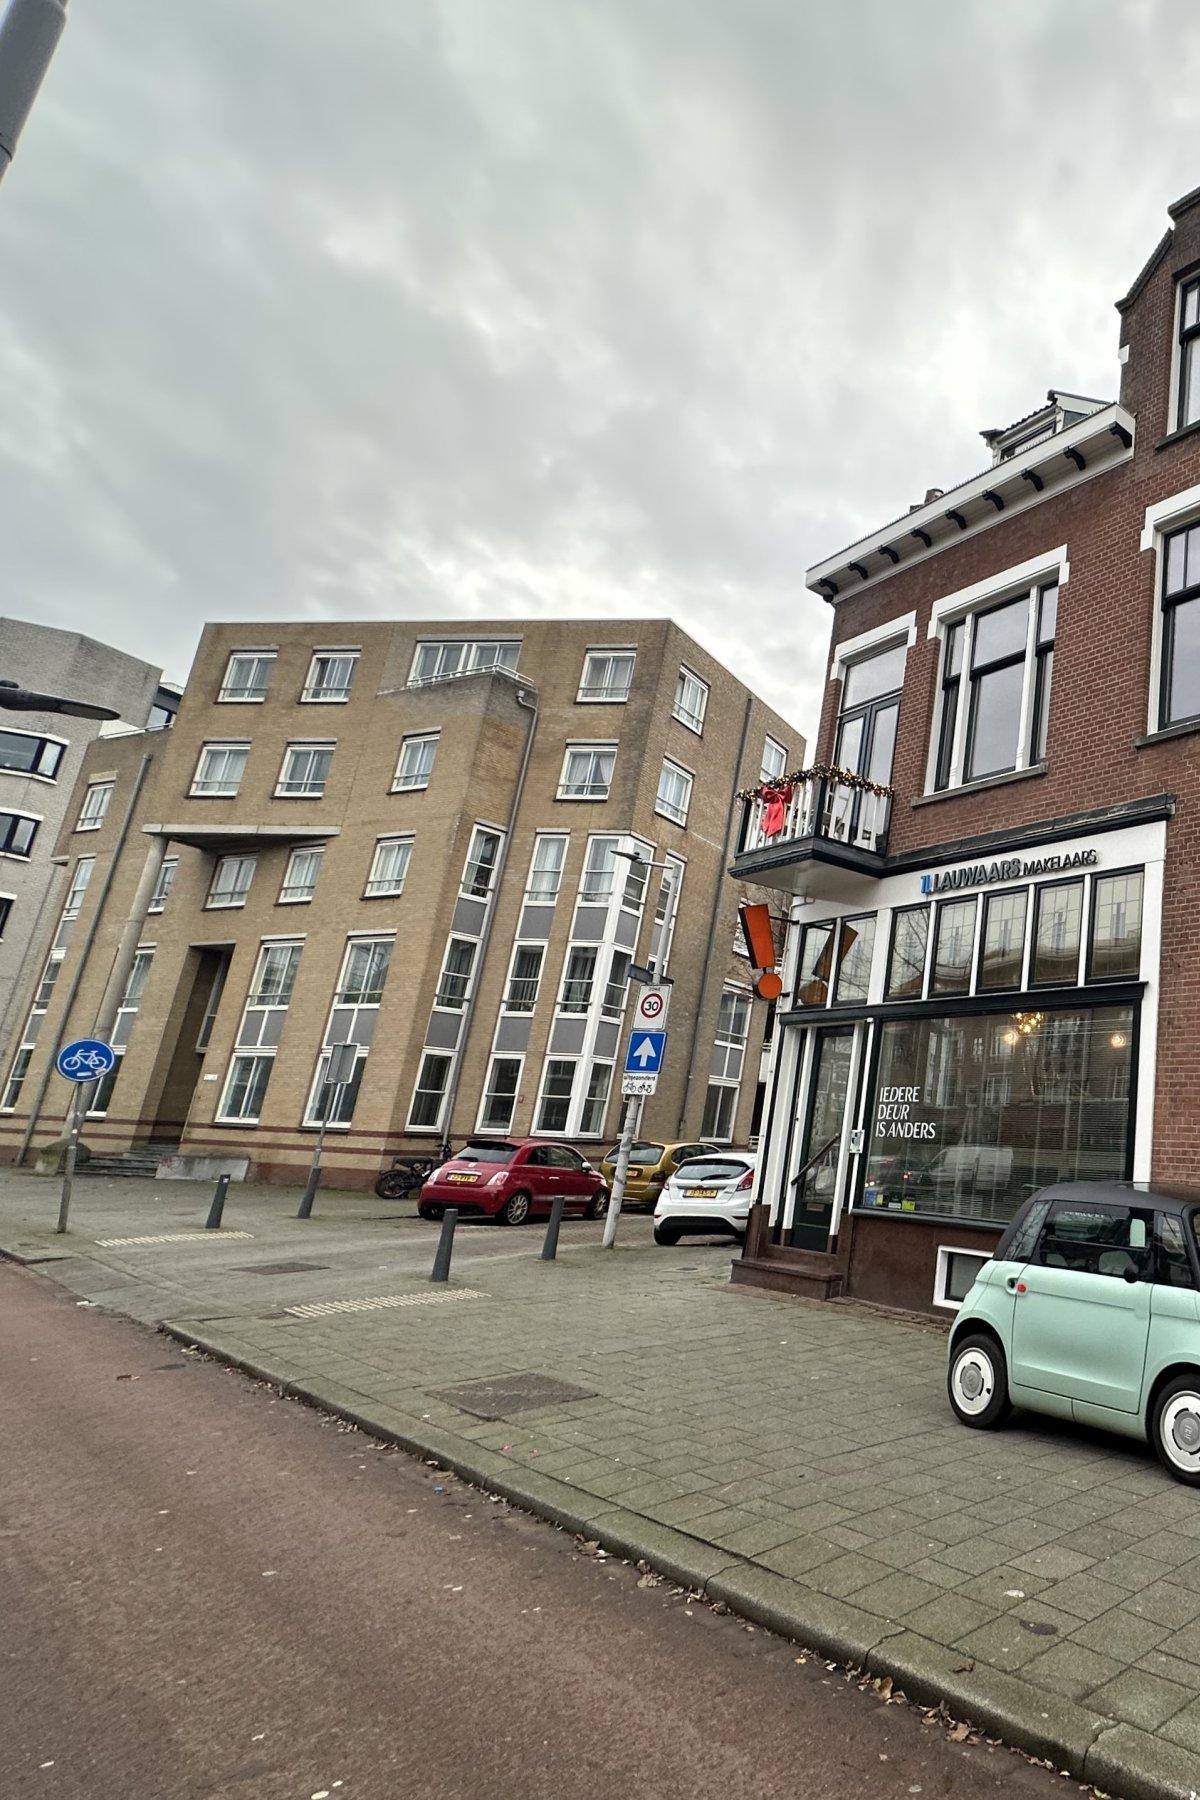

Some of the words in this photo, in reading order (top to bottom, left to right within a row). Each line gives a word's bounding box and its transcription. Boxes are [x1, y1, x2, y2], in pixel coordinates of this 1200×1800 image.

[933, 858, 1021, 892] LAUWAARS
[1023, 849, 1098, 876] MAKELAARS
[644, 1001, 659, 1012] 30
[879, 1086, 921, 1102] IEDERE
[878, 1104, 910, 1120] DEUR
[875, 1121, 886, 1137] IS
[887, 1121, 936, 1139] ANDERS
